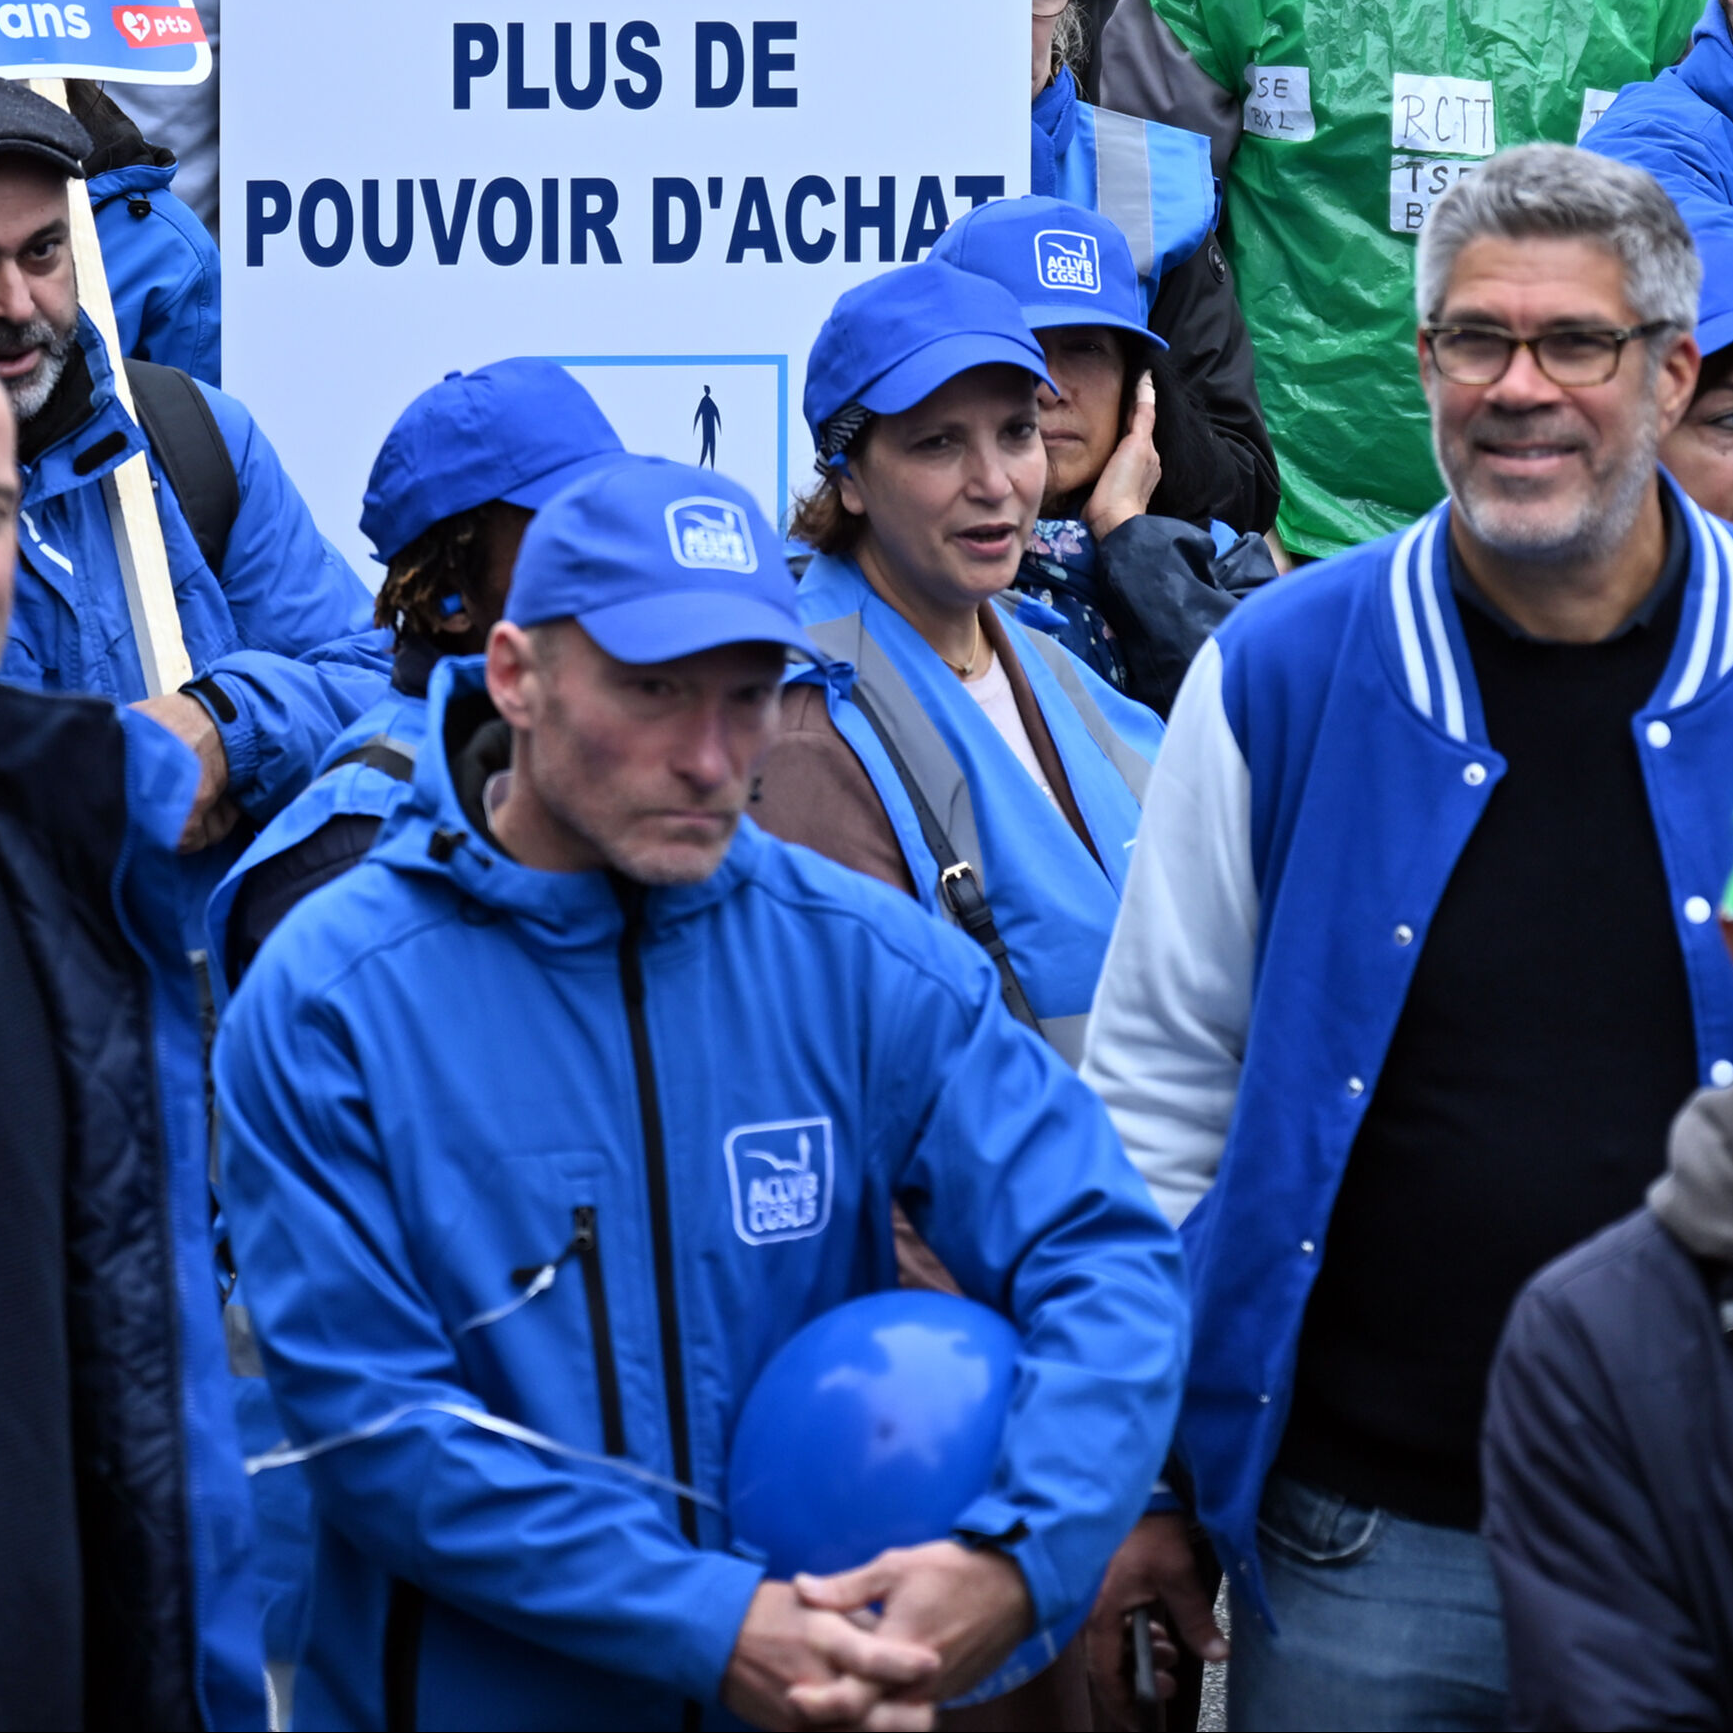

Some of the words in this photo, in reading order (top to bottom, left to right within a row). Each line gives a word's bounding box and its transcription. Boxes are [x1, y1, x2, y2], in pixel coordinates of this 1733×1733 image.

[154, 15, 192, 37] ptb
[453, 20, 663, 111] PLUS
[695, 21, 798, 109] DE
[246, 176, 623, 268] POUVOIR
[1047, 256, 1093, 273] ACLVB
[1047, 269, 1095, 287] CGSLB
